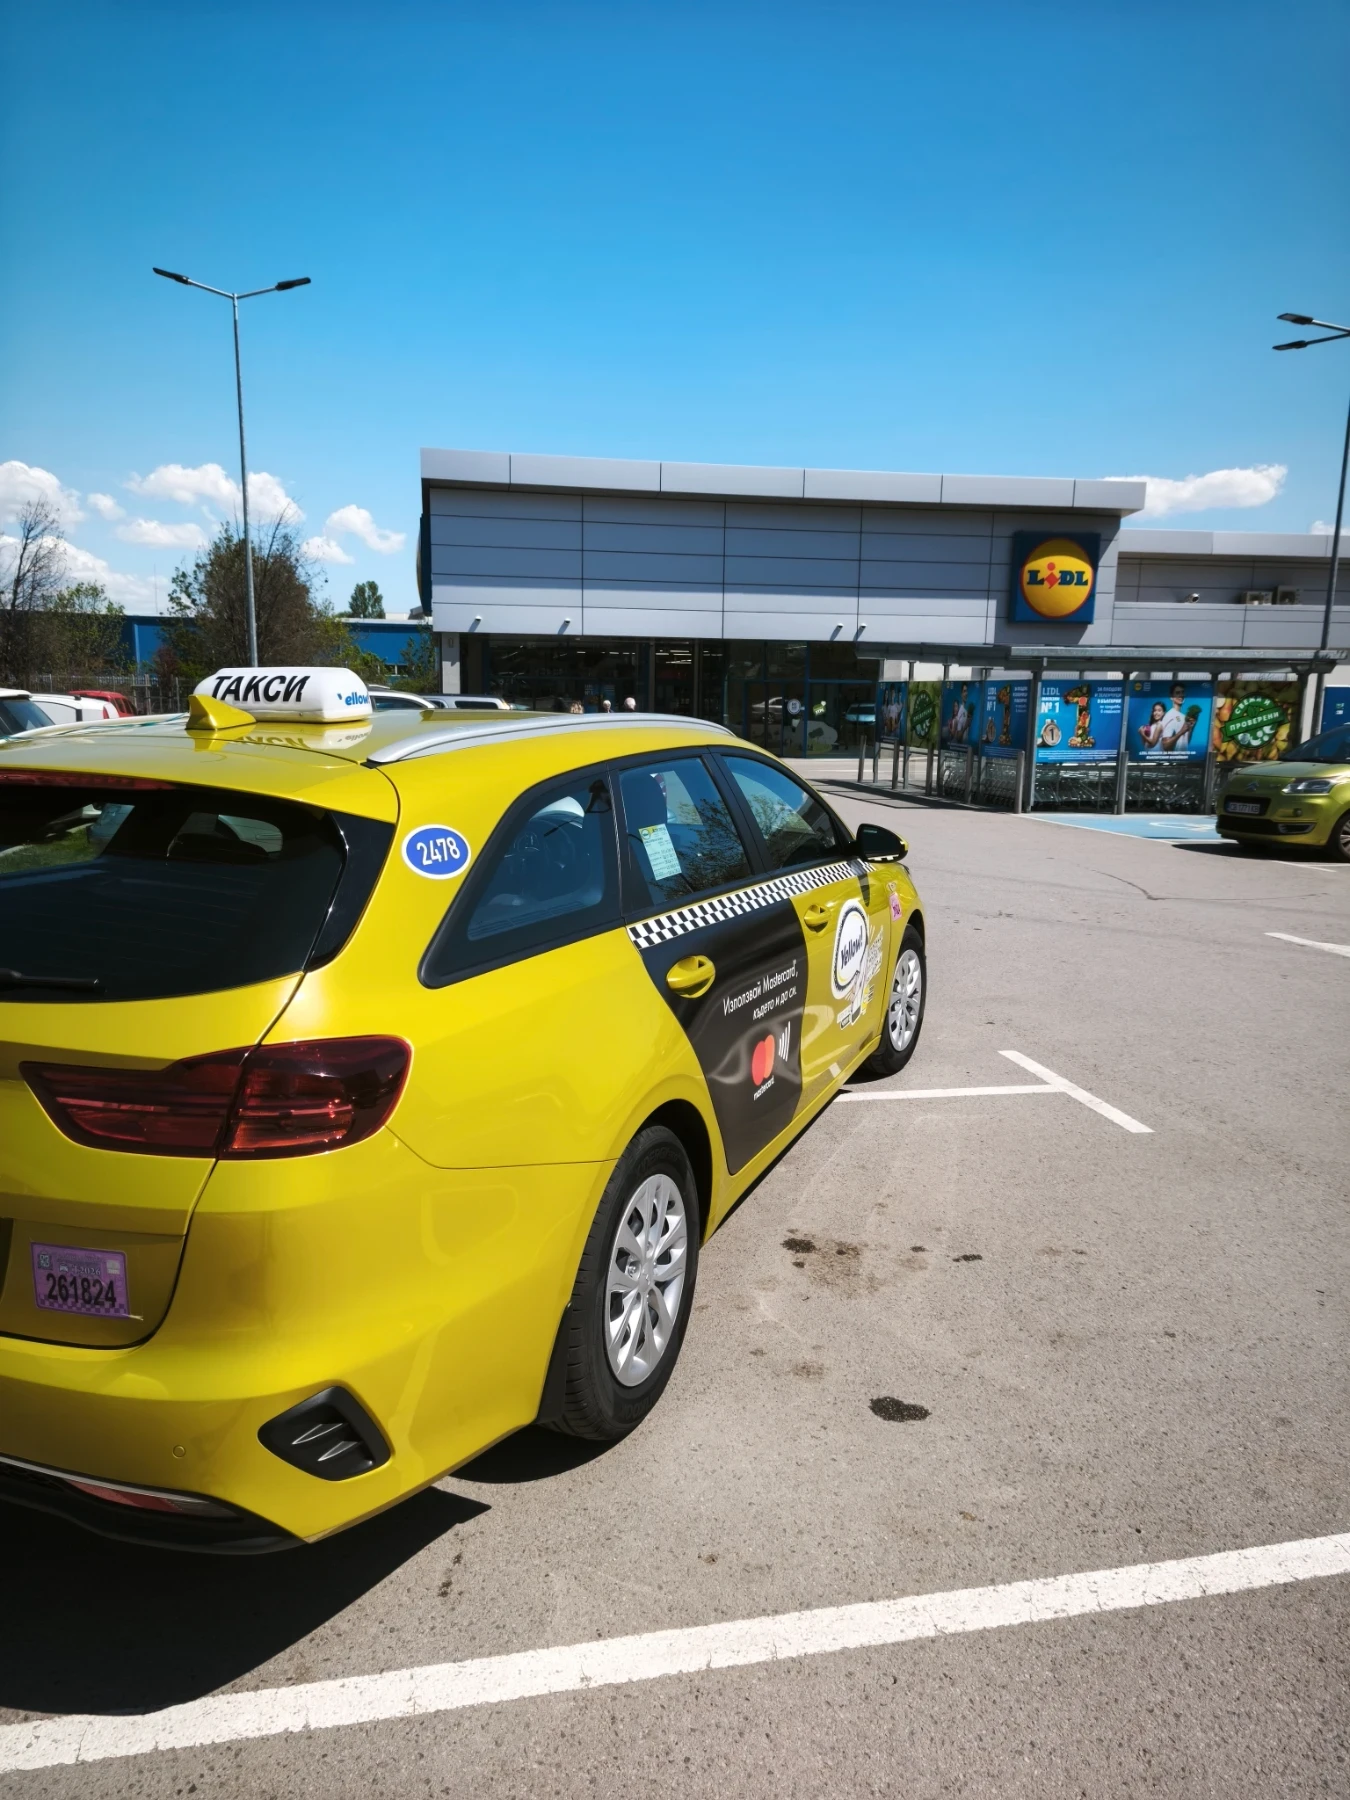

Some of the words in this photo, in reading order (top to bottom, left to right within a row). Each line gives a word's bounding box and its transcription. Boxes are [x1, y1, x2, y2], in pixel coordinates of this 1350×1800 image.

[212, 675, 310, 702] ТАКСИ
[1042, 687, 1060, 696] LIDL
[1229, 711, 1279, 731] ПРОВЕРЕНИ
[416, 837, 461, 866] 2478
[841, 925, 863, 970] Yellow!
[723, 981, 762, 1016] Използвай
[752, 999, 775, 1021] където
[775, 996, 780, 1006] и
[780, 991, 788, 1007] до
[788, 986, 797, 999] си.
[79, 1266, 101, 1275] 2026
[46, 1273, 117, 1308] 261824
